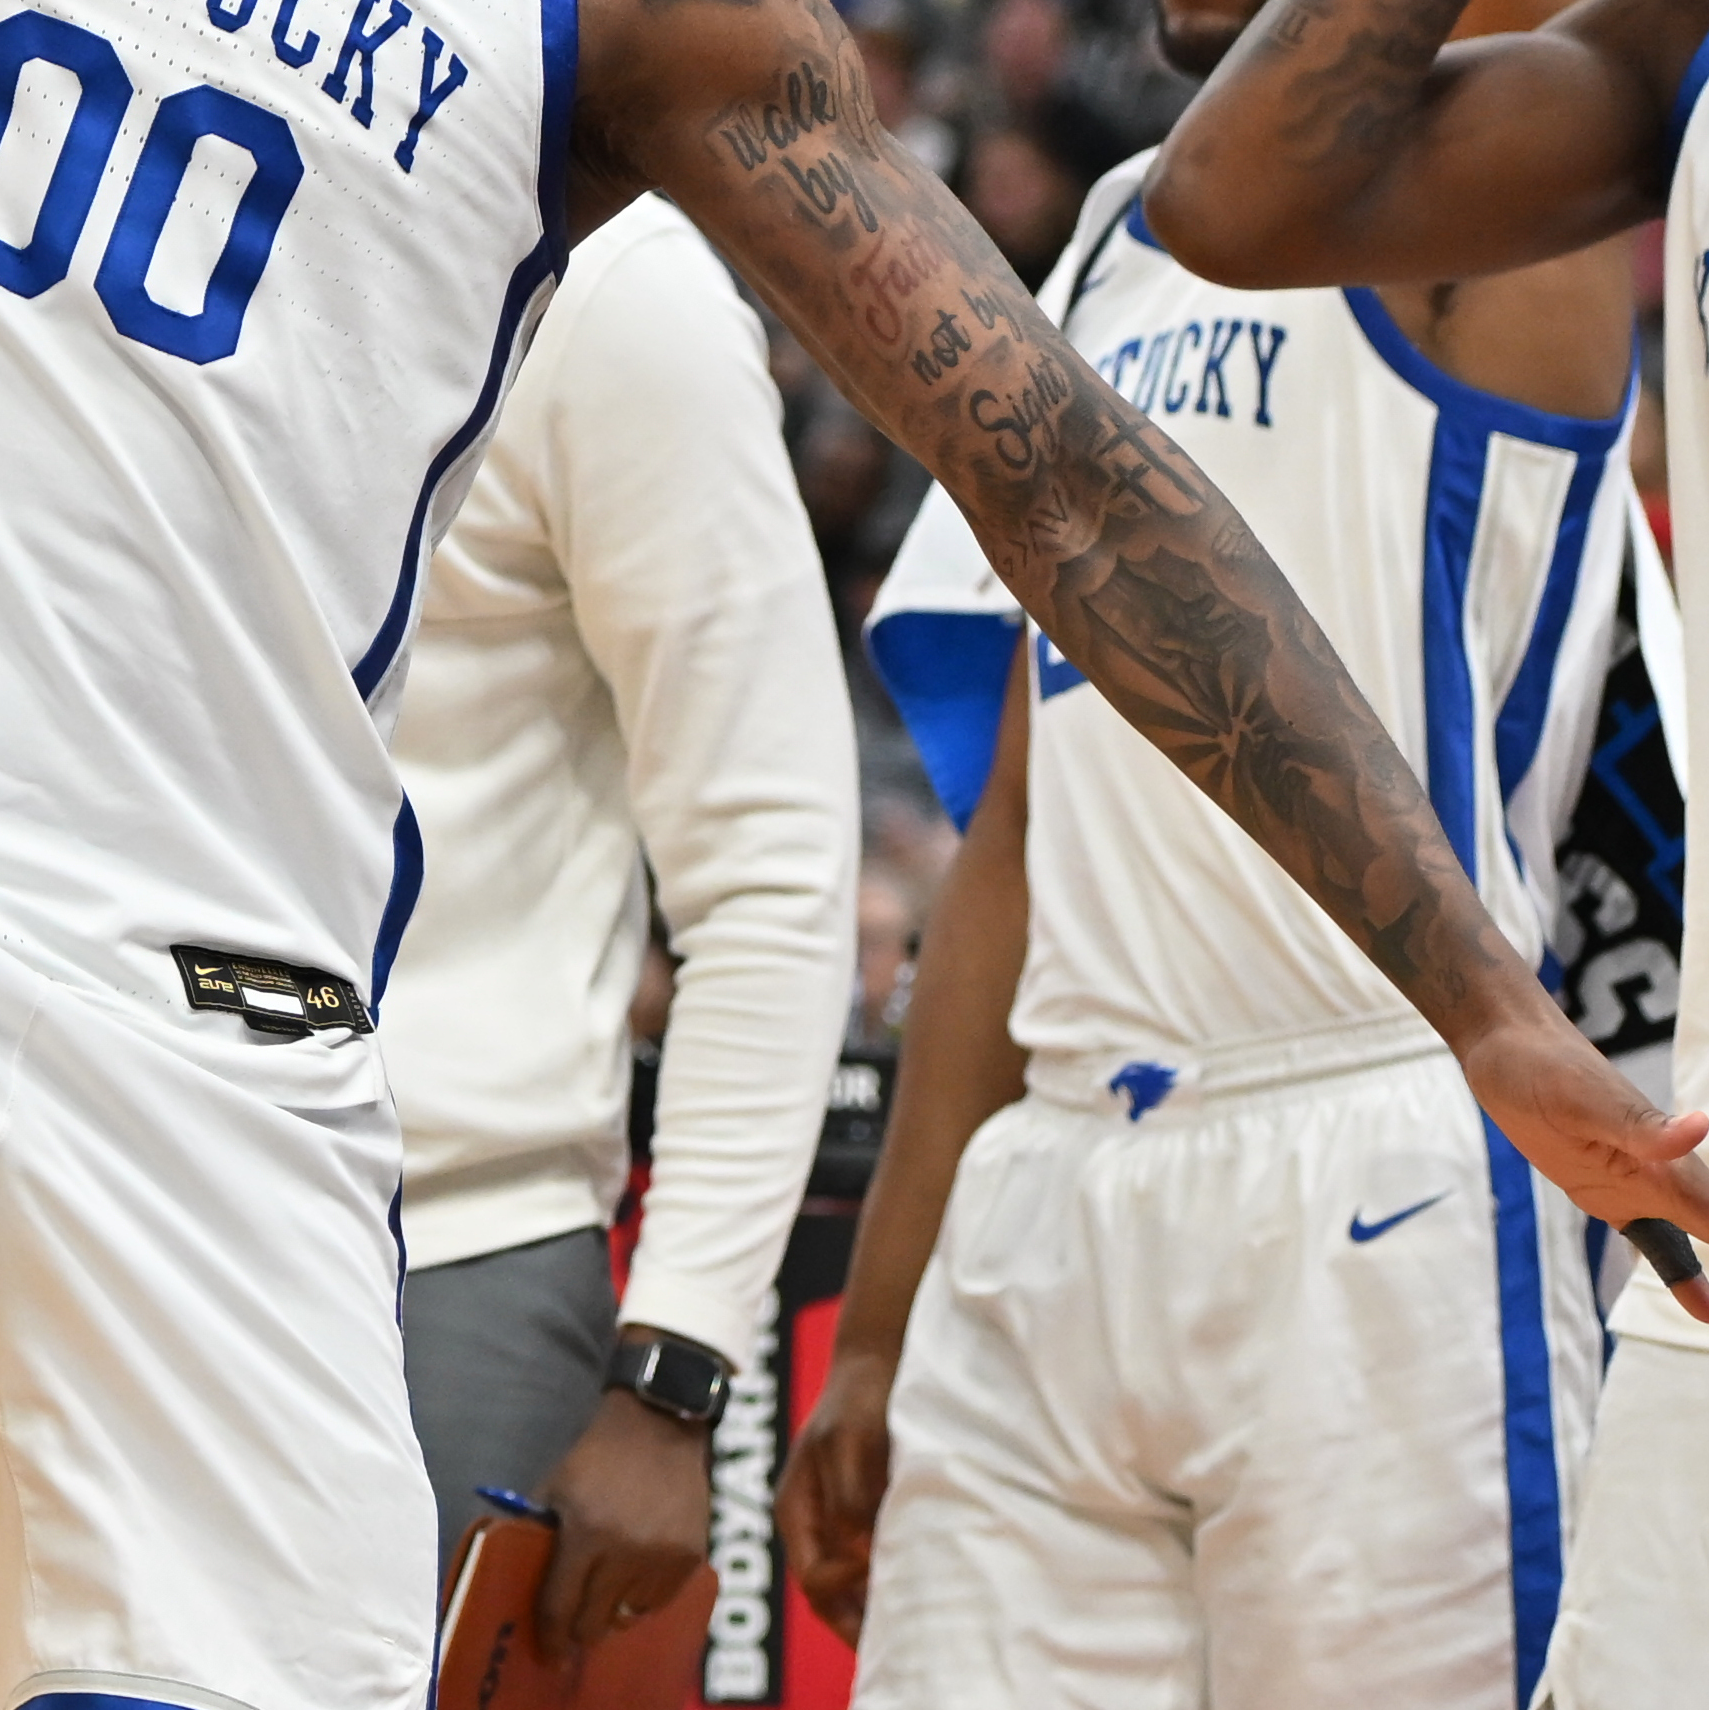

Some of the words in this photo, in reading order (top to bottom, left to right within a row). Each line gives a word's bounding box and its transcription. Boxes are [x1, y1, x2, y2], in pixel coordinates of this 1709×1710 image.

[1096, 317, 1288, 428] TUCKY
[306, 985, 340, 1009] 46
[704, 1283, 781, 1700] BODYAR
